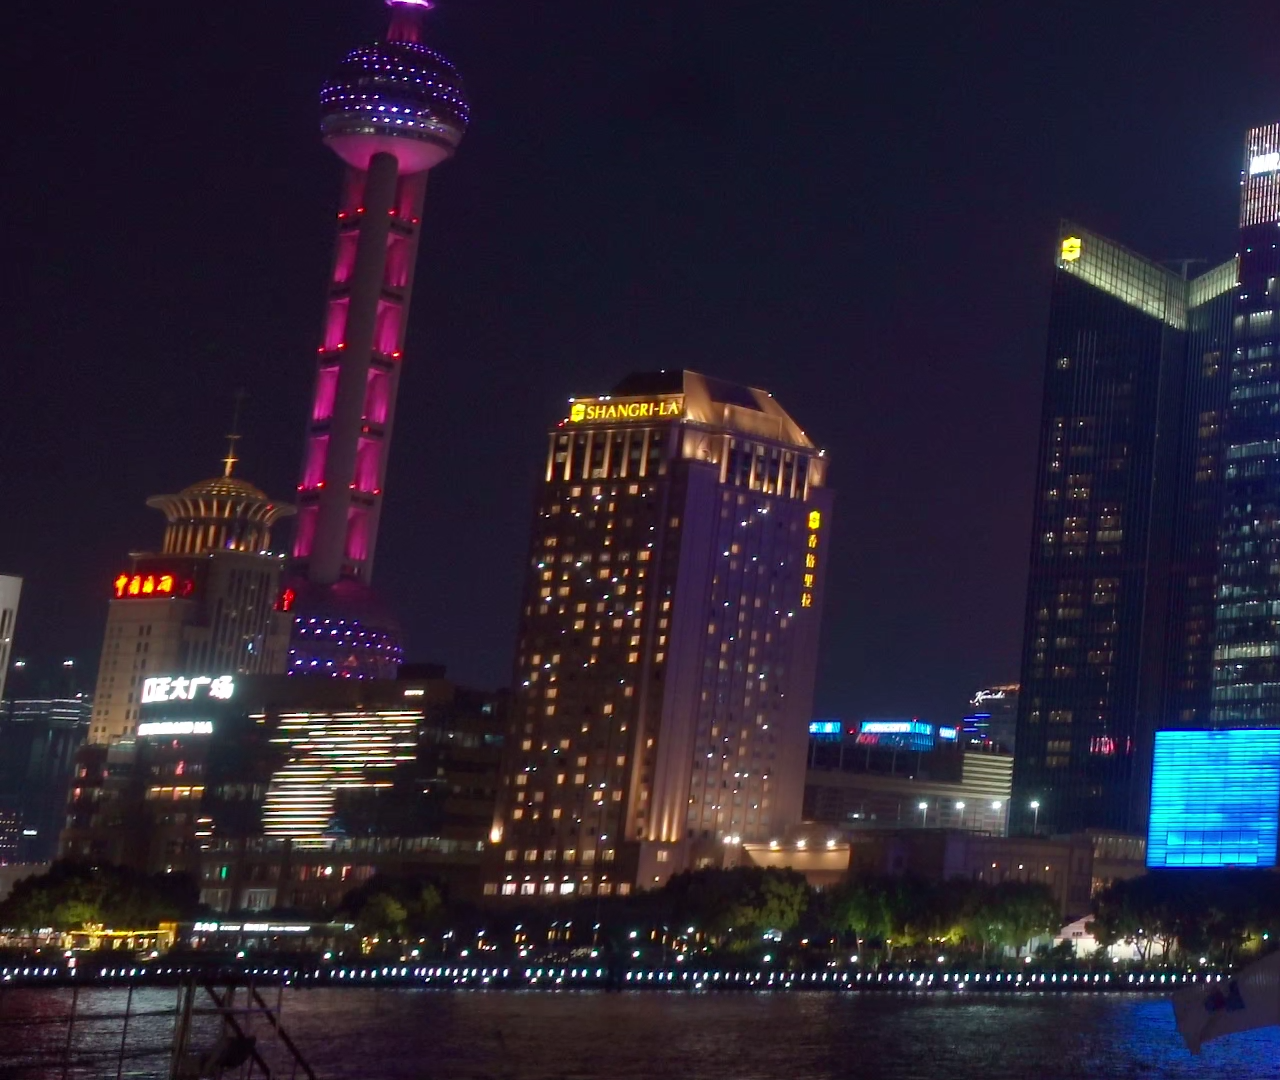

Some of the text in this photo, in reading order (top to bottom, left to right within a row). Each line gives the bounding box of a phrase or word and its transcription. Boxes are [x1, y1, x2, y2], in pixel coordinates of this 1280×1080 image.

[586, 401, 680, 420] SHANGRI-LA
[801, 533, 818, 608] 香格里拉
